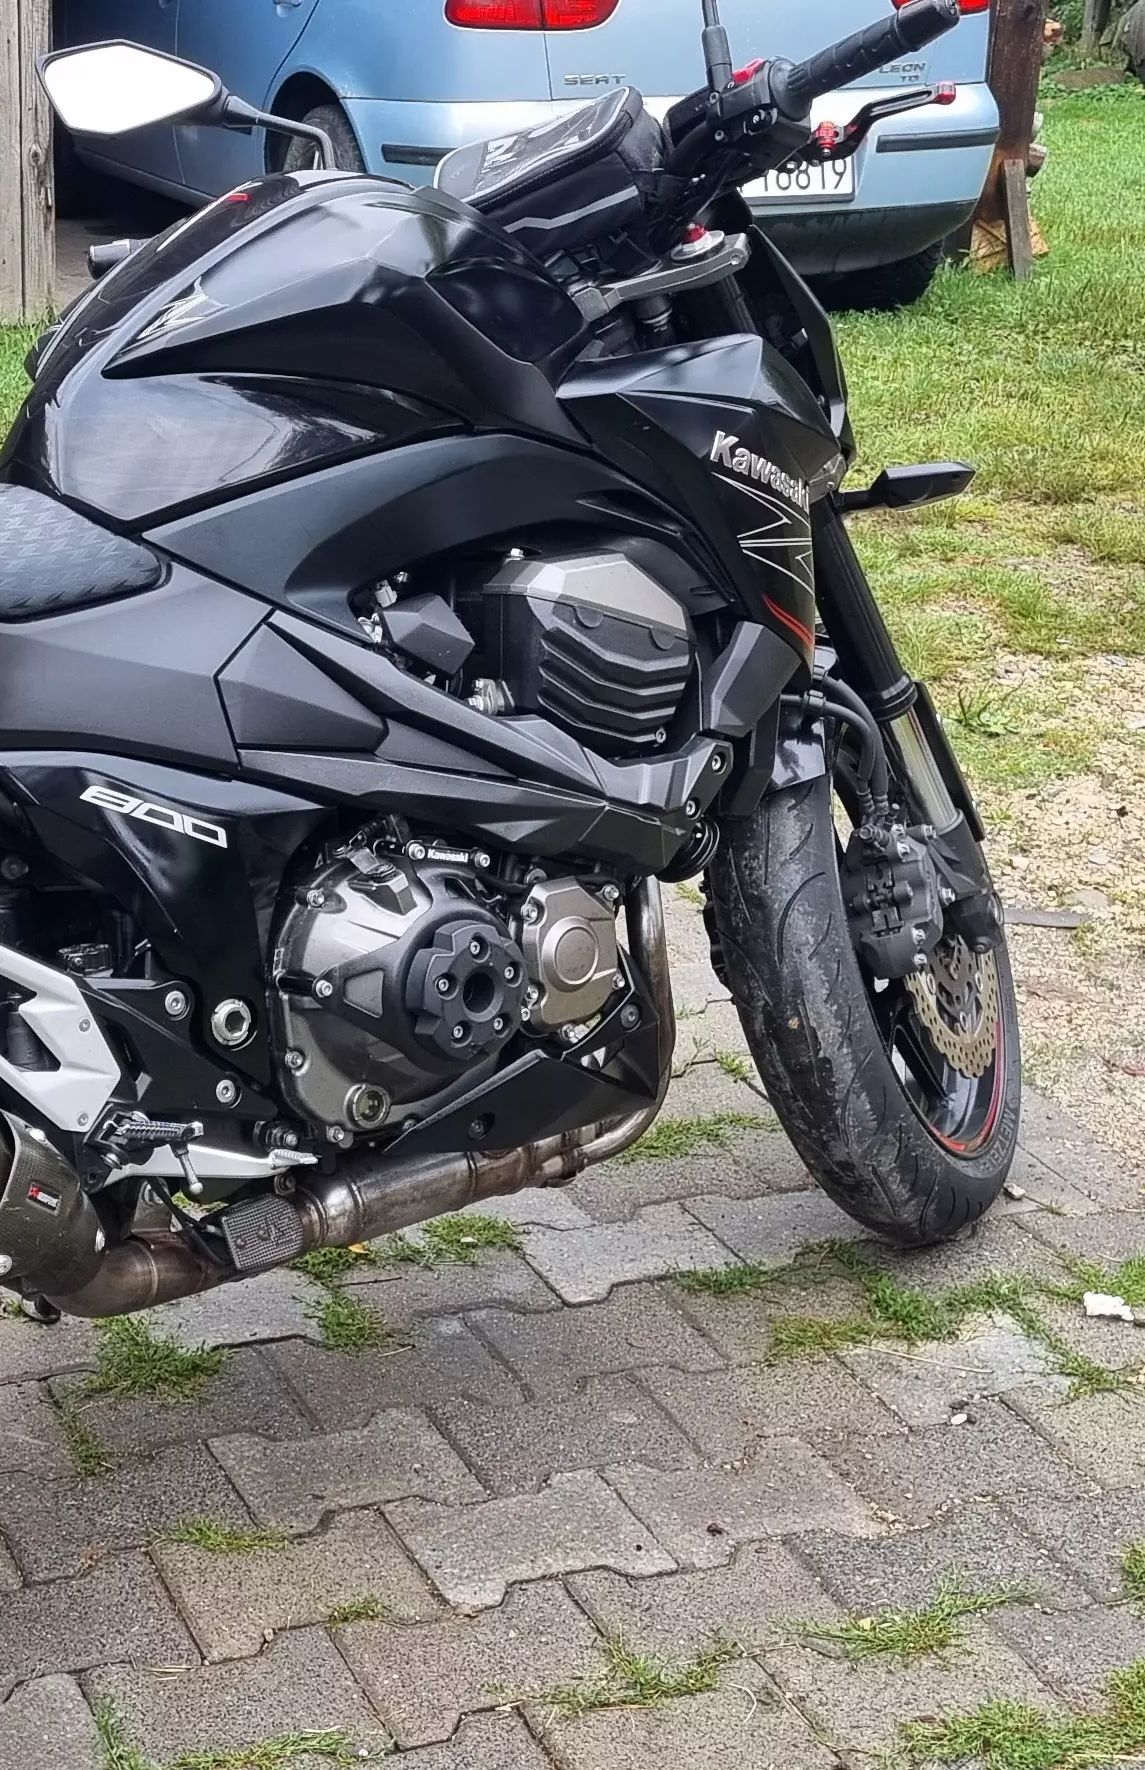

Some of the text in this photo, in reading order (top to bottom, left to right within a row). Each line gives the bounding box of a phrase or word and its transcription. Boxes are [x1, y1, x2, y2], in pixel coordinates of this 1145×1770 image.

[878, 62, 926, 74] LEON
[564, 74, 626, 86] SEAT
[709, 430, 811, 515] Kawasaki
[79, 785, 228, 849] 800
[427, 848, 469, 863] Kawasaki
